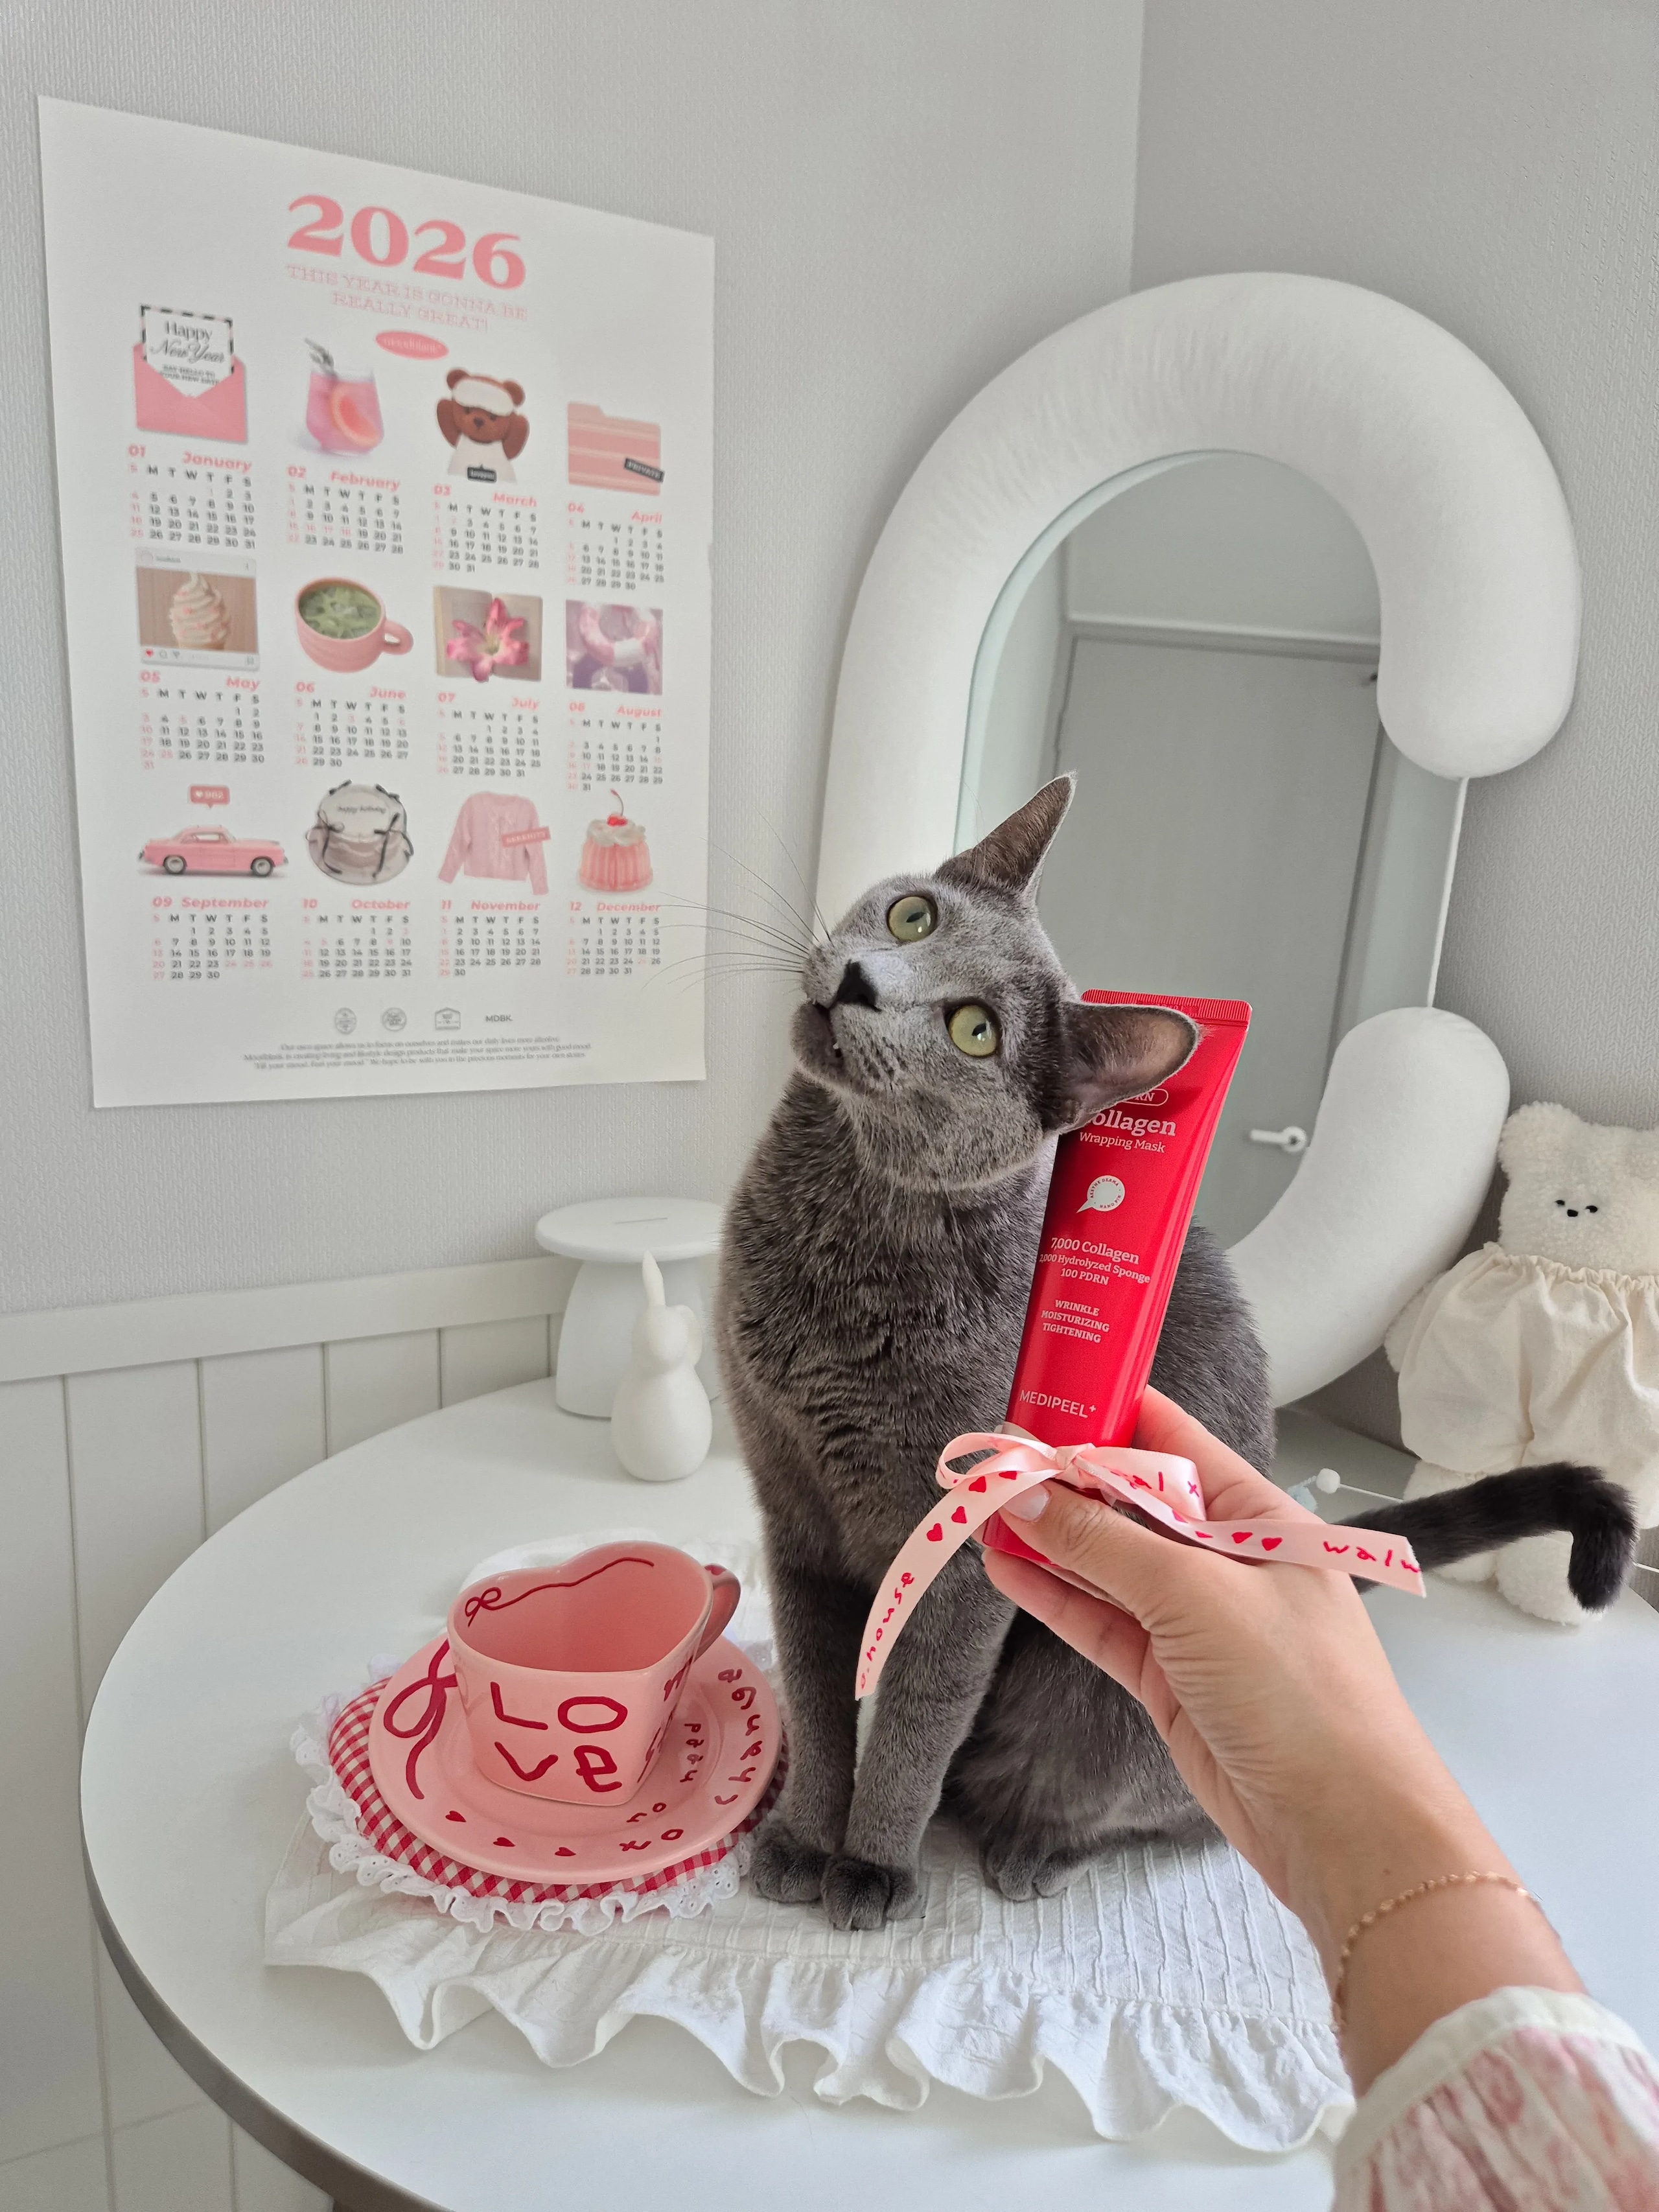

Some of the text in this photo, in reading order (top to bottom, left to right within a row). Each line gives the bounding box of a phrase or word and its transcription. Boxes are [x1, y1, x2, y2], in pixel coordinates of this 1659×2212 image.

[287, 194, 526, 290] 2026
[286, 264, 529, 321] THIS YEAR IS GONNA BE
[332, 292, 488, 332] REALLY GREAT!
[165, 321, 213, 342] Happy
[150, 338, 226, 364] New Year
[128, 445, 251, 473] 01 January
[627, 460, 661, 478] PRIVATE
[288, 465, 399, 492] 02 February
[434, 485, 537, 507] 03 March
[568, 502, 662, 524] 04 April
[140, 670, 259, 692] 05 May
[296, 681, 406, 699] 06 June
[437, 692, 539, 710] 07 July
[569, 702, 661, 719] 08 August
[152, 897, 269, 909] 09 September
[303, 899, 410, 910] 10 October
[441, 900, 540, 911] 11 November
[570, 902, 660, 912] 12 December
[1091, 1109, 1176, 1137] ollagen
[1080, 1132, 1166, 1154] Wrapping Mask
[1102, 1178, 1119, 1187] DERMA
[1050, 1237, 1139, 1264] 7,000 Collagen
[1039, 1253, 1151, 1284] 2,000 Hydrolyzed Sponge
[1061, 1268, 1109, 1286] 100 PDRN
[1055, 1299, 1100, 1316] WRINKLE
[1041, 1310, 1110, 1333] MOISTURIZING
[1043, 1322, 1101, 1344] TIGHTENING
[619, 1828, 684, 1851] to
[713, 1668, 763, 1806] change
[626, 1802, 667, 1823] no
